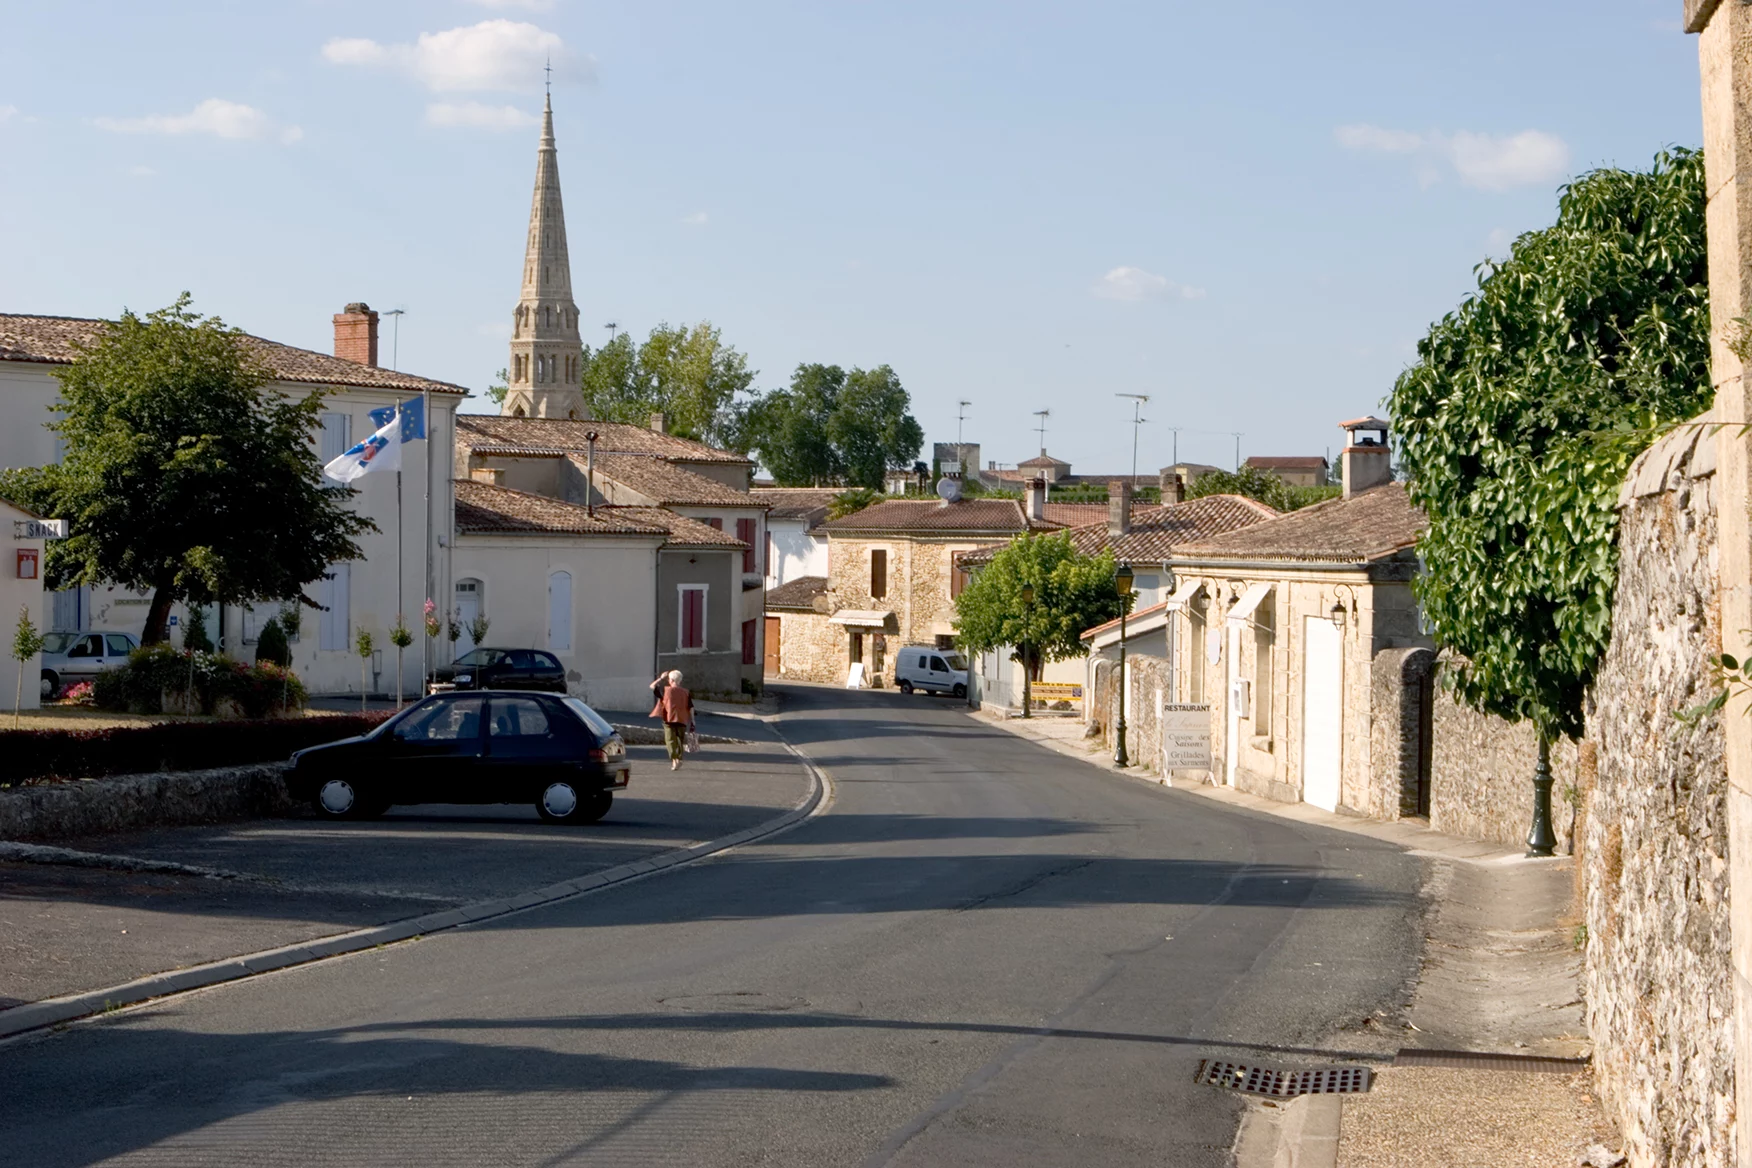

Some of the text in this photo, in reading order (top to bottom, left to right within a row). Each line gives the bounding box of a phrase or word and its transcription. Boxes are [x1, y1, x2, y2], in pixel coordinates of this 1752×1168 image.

[29, 522, 59, 537] SNACK
[1168, 733, 1210, 741] Cuisine des
[1174, 740, 1204, 748] Saisons
[1170, 750, 1205, 759] Grillades
[1179, 758, 1209, 767] Sarments
